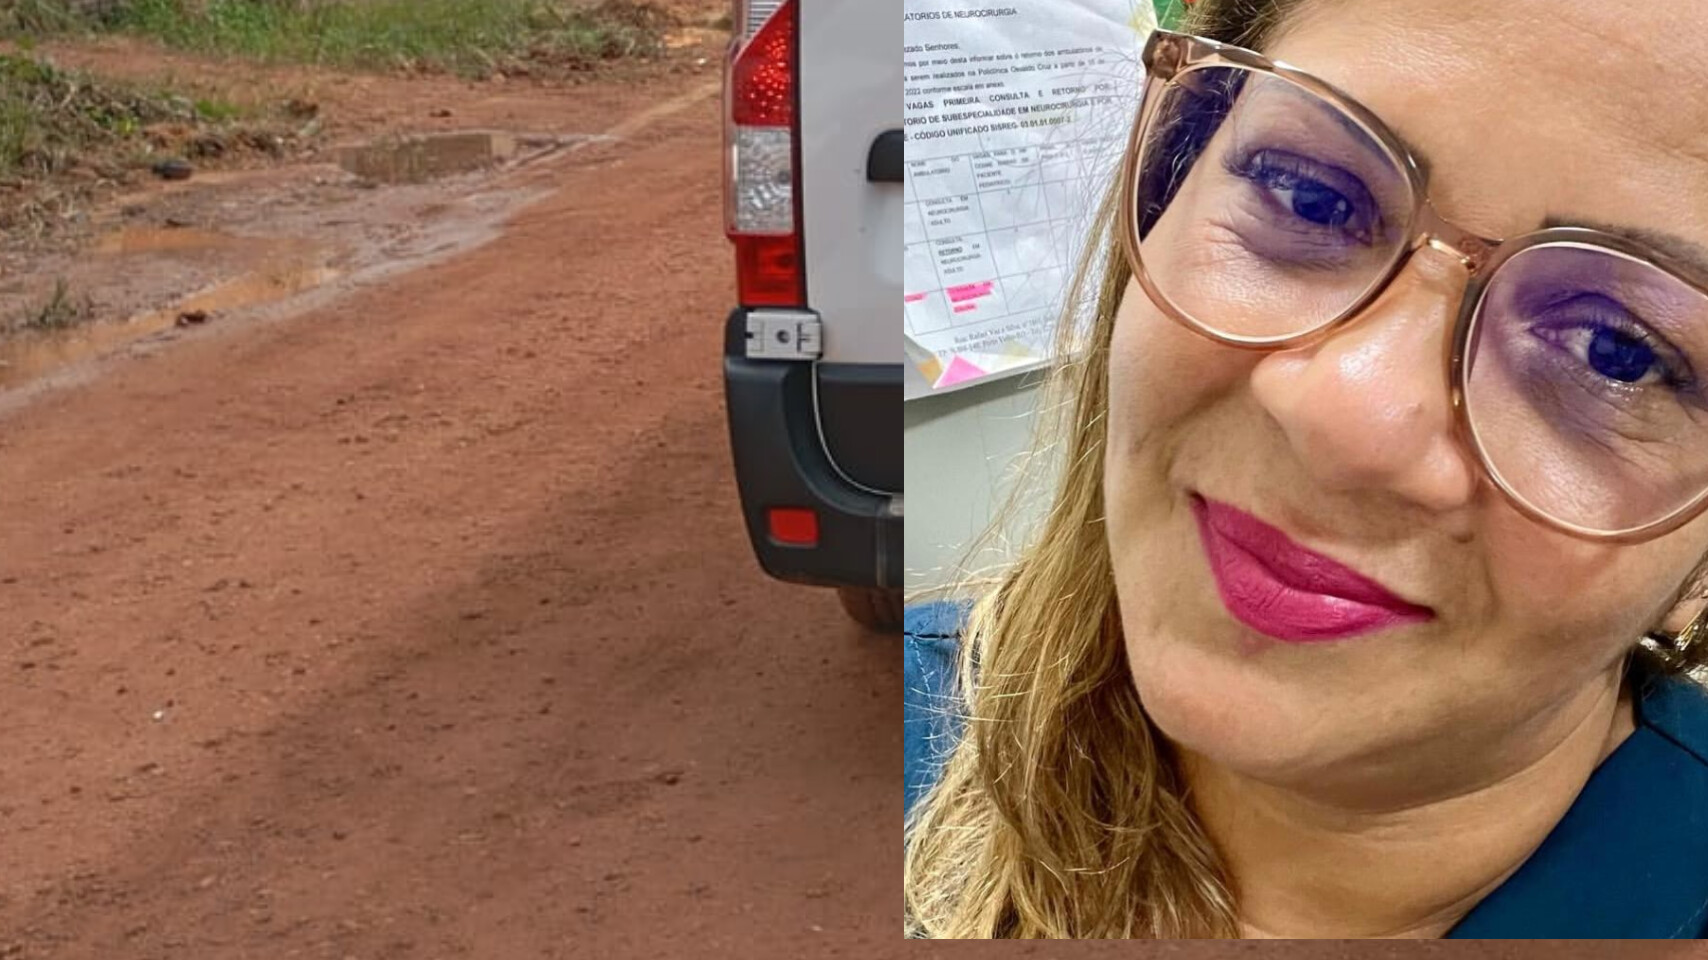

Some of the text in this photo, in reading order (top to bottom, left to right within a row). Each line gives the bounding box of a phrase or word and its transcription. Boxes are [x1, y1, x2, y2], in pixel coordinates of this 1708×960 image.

[942, 10, 952, 19] DE
[954, 8, 1018, 19] NEUROCIRURGIA
[906, 100, 934, 111] VAGAS
[943, 96, 981, 107] PRIMEIRA
[989, 92, 1030, 103] CONSULTA
[1051, 86, 1087, 96] RETORNO
[928, 114, 940, 124] DE
[942, 107, 1017, 122] SUBESPECIALIDADE
[1018, 106, 1029, 114] EM
[947, 124, 989, 136] UNIFICADO
